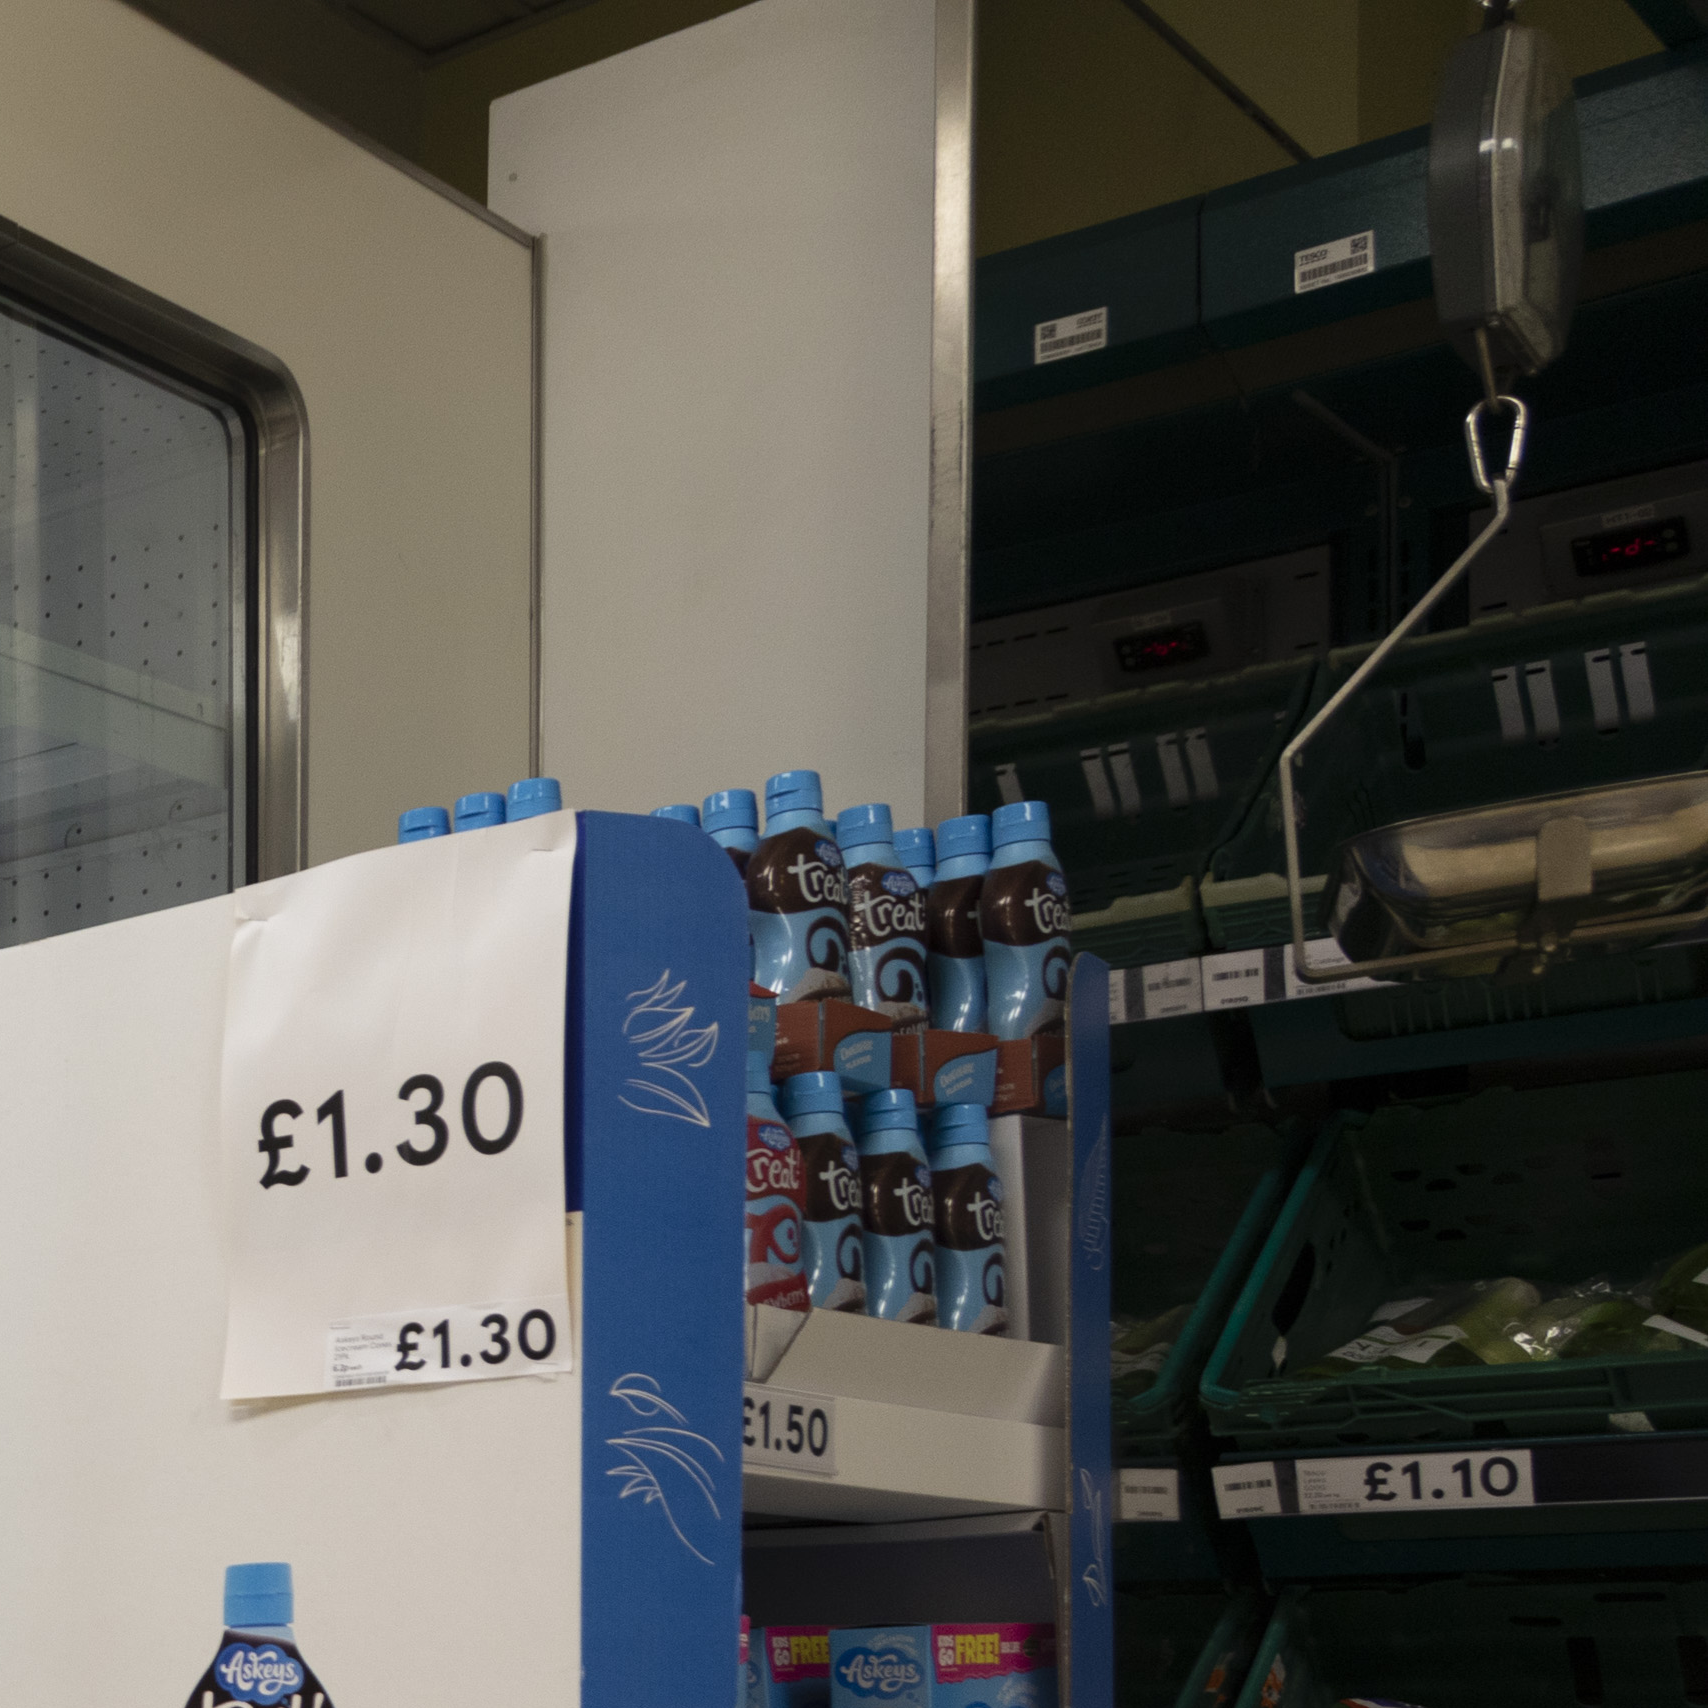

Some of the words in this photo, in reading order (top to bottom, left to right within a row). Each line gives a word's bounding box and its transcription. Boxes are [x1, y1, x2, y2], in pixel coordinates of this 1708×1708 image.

[1299, 248, 1328, 264] TESCO
[257, 1059, 525, 1192] £1.30
[394, 1307, 557, 1372] £1.30
[1363, 1453, 1520, 1503] £1.10
[218, 1648, 300, 1693] Askeys
[955, 1631, 1000, 1666] FREE!
[839, 1653, 920, 1692] Askeys
